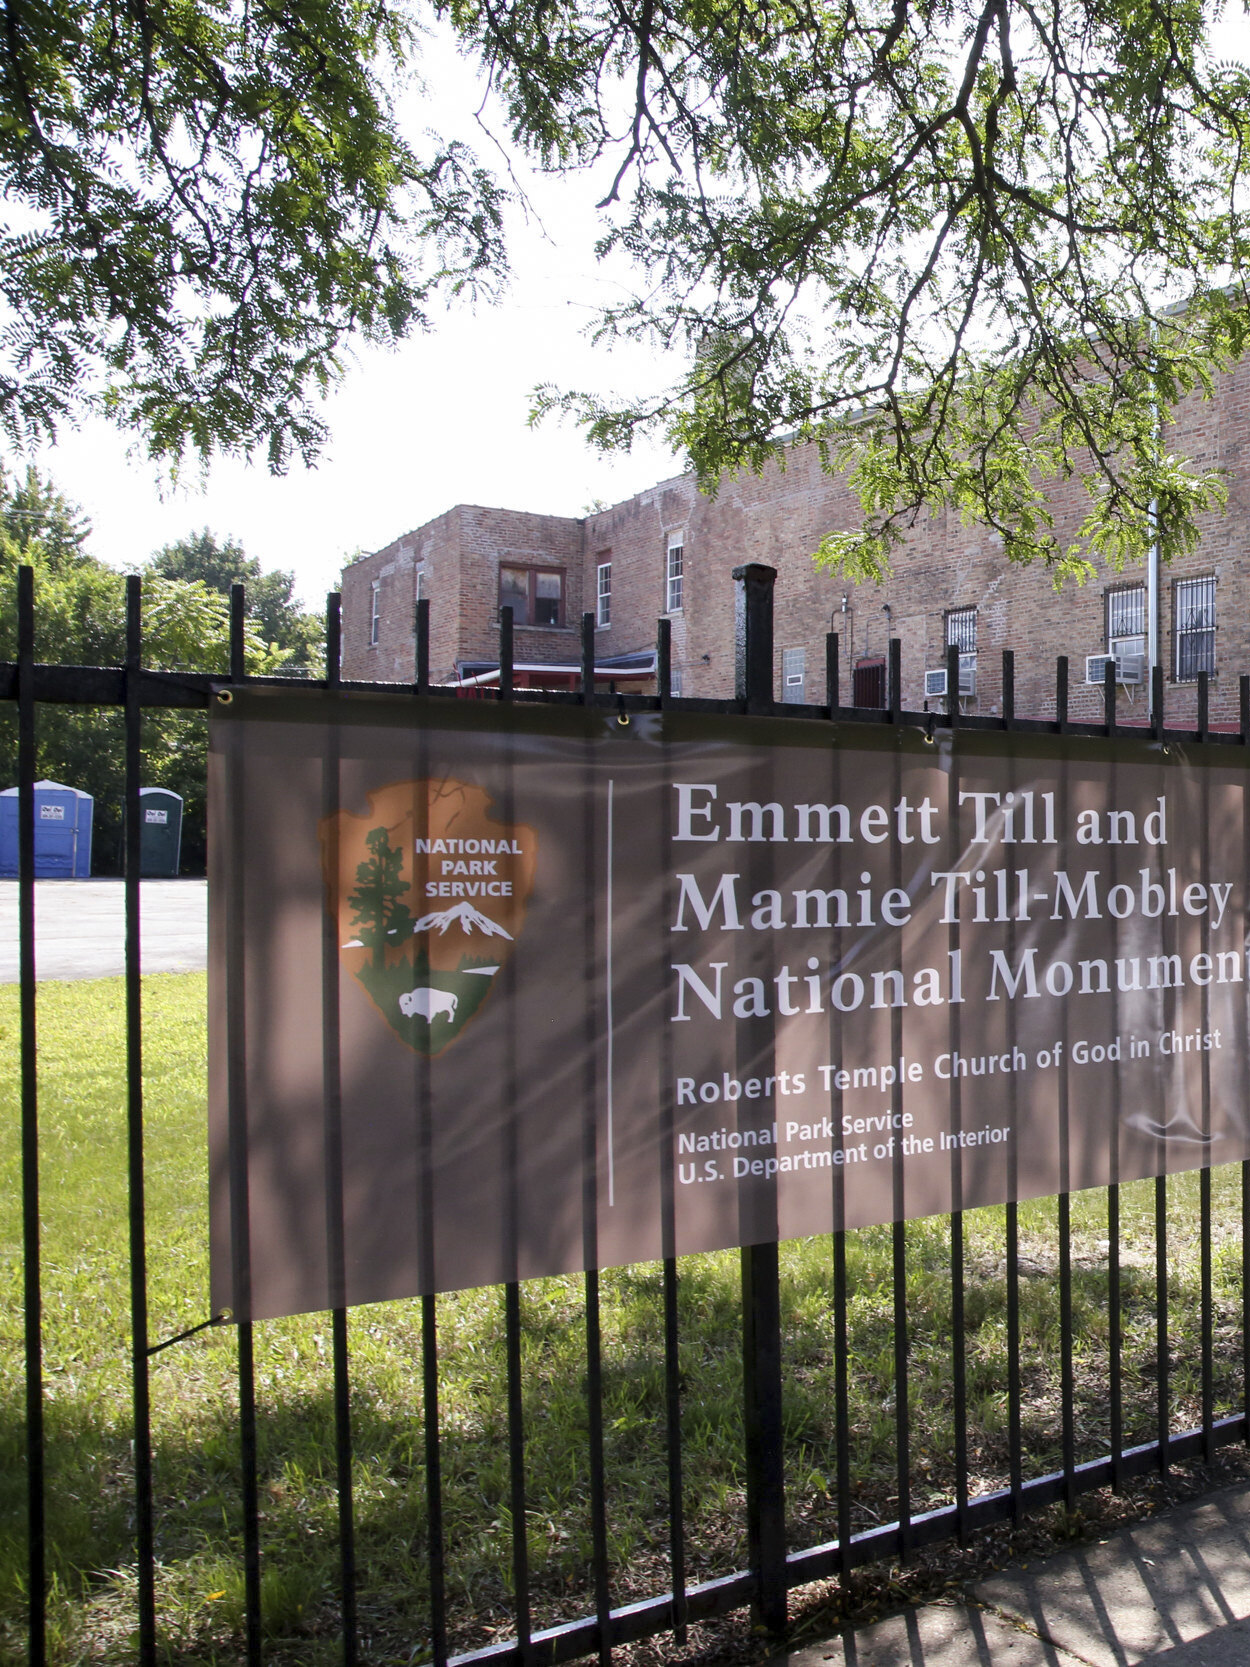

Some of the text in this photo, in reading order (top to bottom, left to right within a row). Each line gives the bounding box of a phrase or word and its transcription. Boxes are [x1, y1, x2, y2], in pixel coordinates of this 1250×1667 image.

[415, 838, 523, 855] NATIONAL
[672, 782, 1168, 847] Emmett Till and
[425, 881, 513, 898] SERVICE
[441, 860, 498, 876] PARK
[671, 866, 1234, 933] Mamie Till-Mobley
[671, 948, 966, 1022] National
[676, 1027, 1223, 1106] Roberts Temple Church of God in Christ
[678, 1107, 914, 1155] National Park Service
[678, 1122, 1011, 1186] U.S. Department of the Interior
